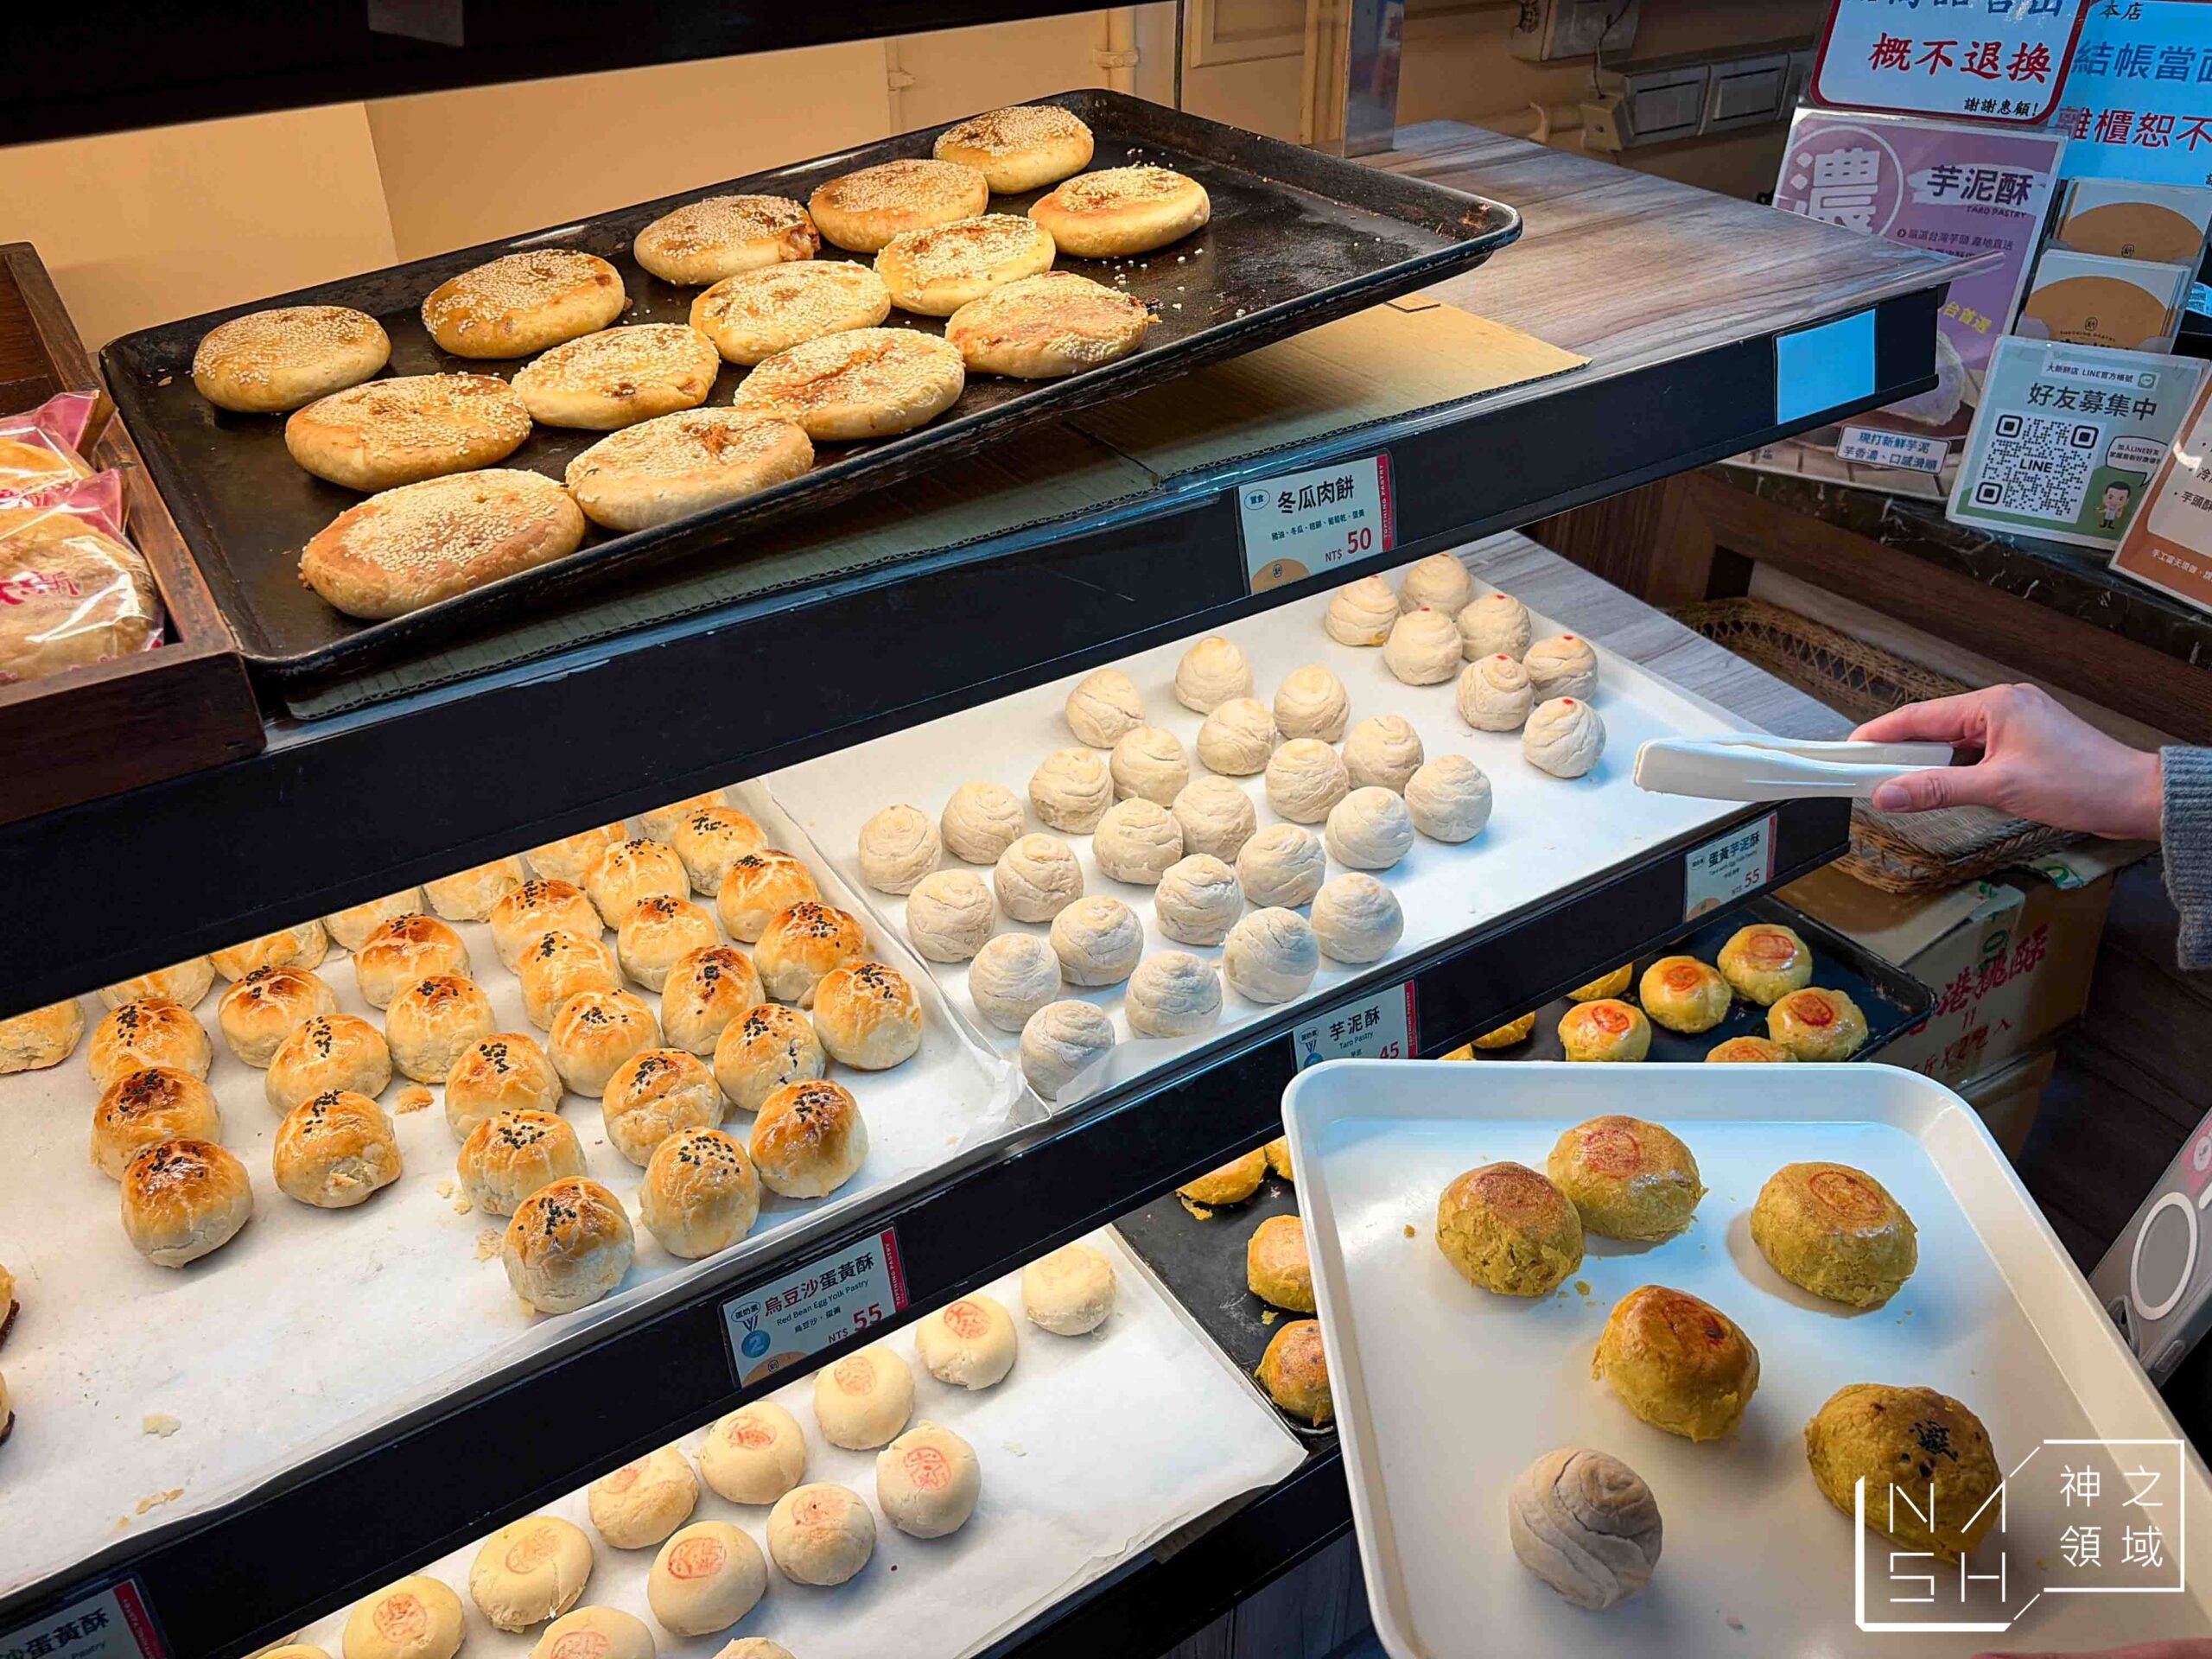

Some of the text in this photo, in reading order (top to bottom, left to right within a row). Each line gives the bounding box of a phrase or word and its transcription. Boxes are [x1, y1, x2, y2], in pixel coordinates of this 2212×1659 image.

[2099, 3, 2144, 20] 本店
[1868, 32, 2052, 84] 概不退換
[1927, 164, 2034, 207] 芋泥酥
[1992, 207, 2027, 219] PASTRY
[2027, 381, 2158, 422] 好友募集中
[2019, 458, 2054, 474] LINE
[1277, 475, 1354, 514] 冬瓜肉餅
[1325, 548, 1343, 562] NT$
[1347, 527, 1372, 554] 50
[1745, 868, 1760, 888] 55
[1329, 1005, 1381, 1042] 芋泥酥
[1339, 1031, 1374, 1050] Taro Pastry
[1379, 1040, 1400, 1058] 45
[765, 1252, 875, 1317] 烏豆沙蛋黃酥
[776, 1279, 869, 1326] Red Bean Egg Yolk Pastry
[734, 1303, 760, 1319] 蛋奶素
[827, 1302, 883, 1344] NT$ 55
